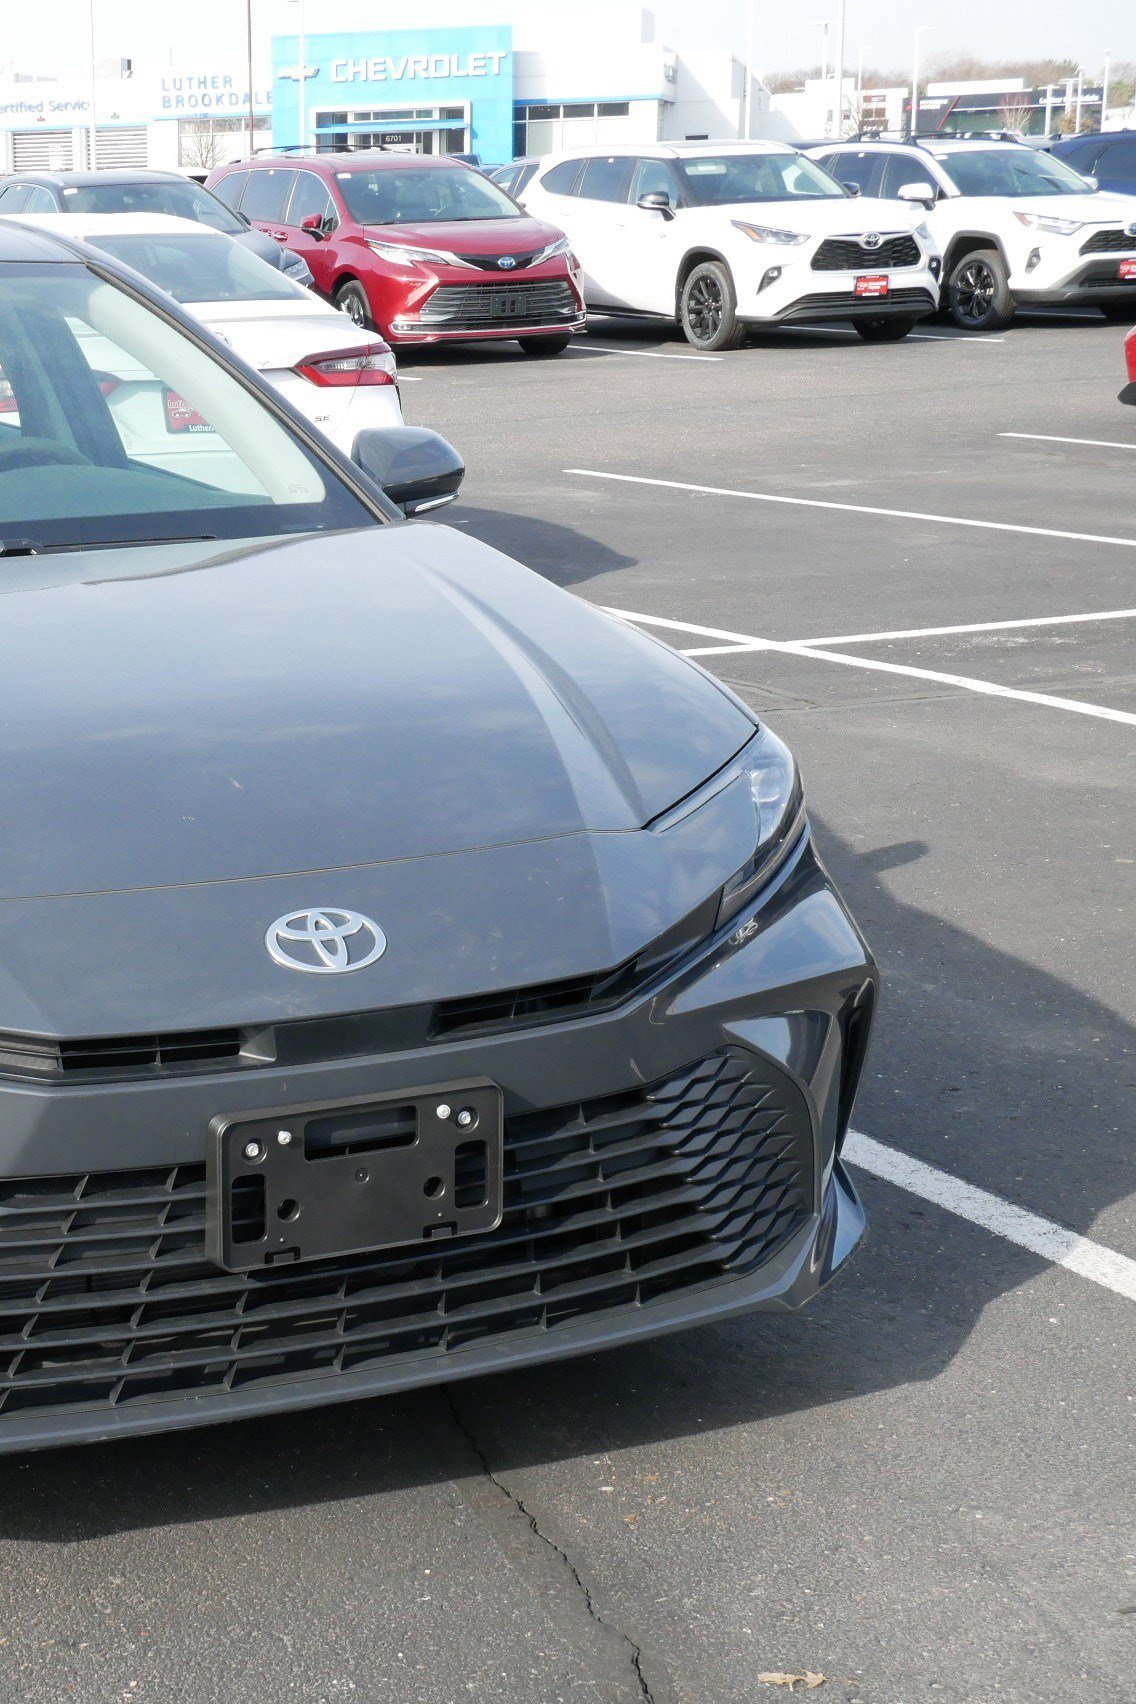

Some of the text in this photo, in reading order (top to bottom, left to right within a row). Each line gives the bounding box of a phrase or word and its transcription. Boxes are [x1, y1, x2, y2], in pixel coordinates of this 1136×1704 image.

[330, 52, 508, 83] CHEVROLET
[161, 75, 233, 92] LUTHER
[48, 100, 91, 112] Servic
[314, 414, 331, 422] SE
